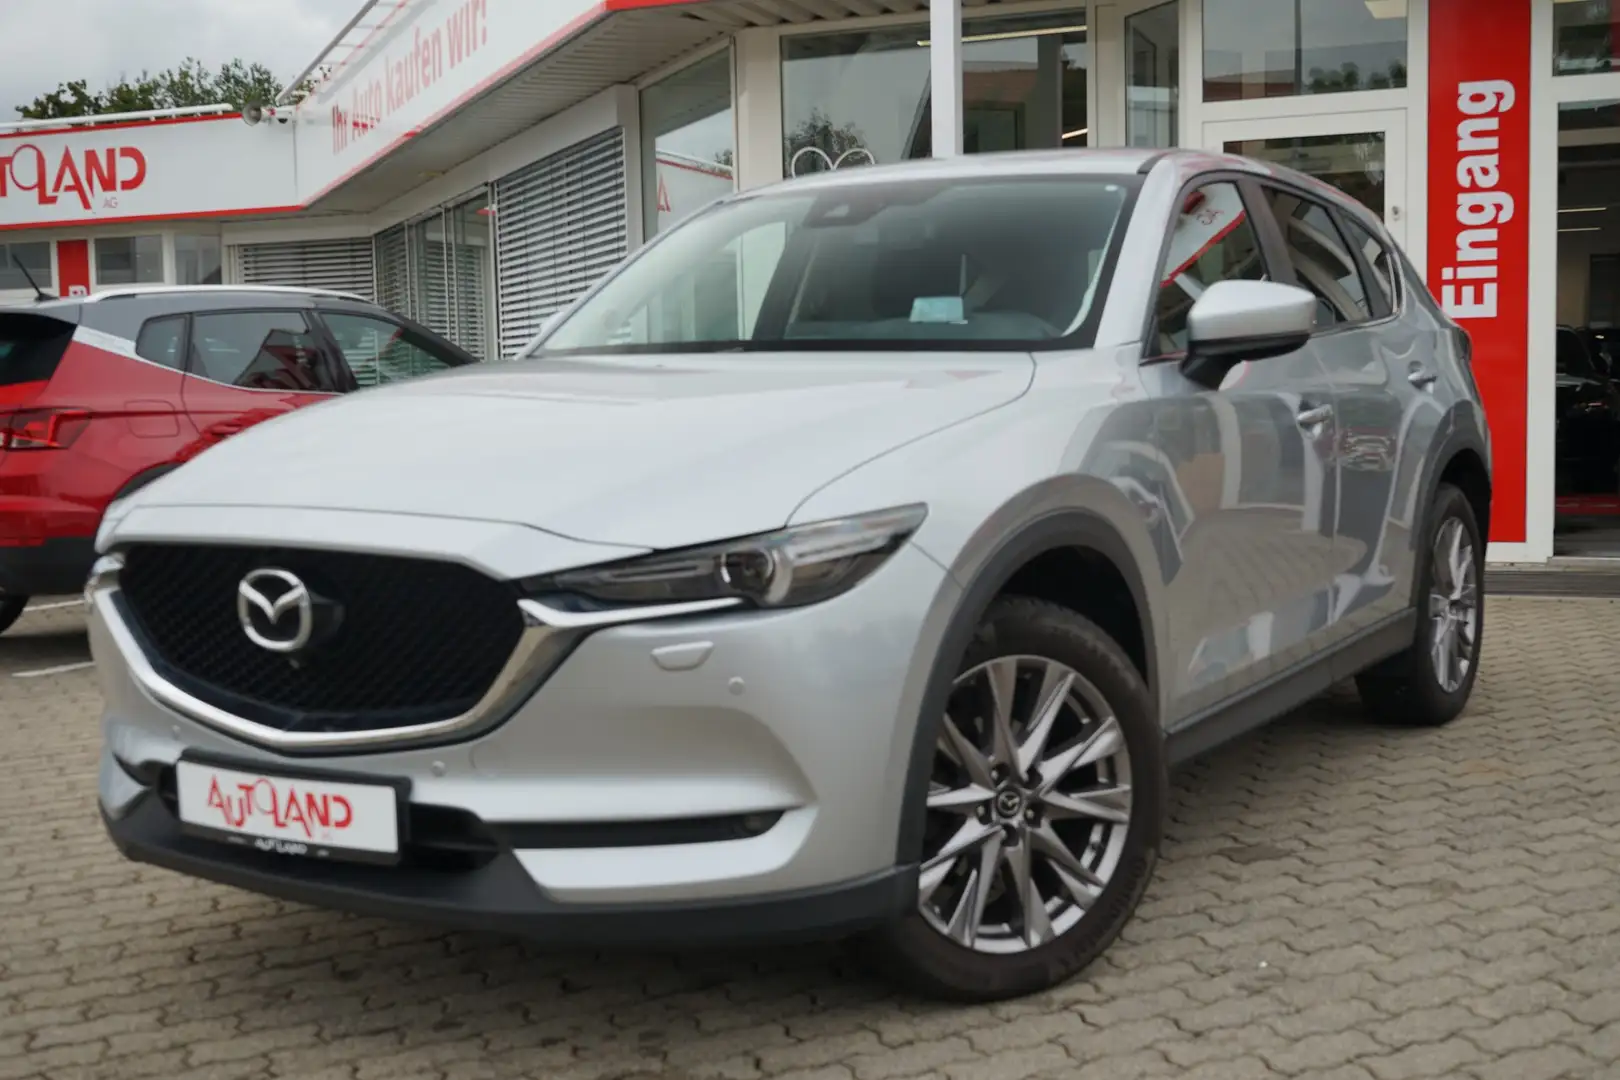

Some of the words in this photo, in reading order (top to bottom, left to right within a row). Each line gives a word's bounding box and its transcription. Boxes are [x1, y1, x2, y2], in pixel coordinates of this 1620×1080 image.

[351, 79, 382, 142] Auto
[384, 25, 443, 116] kaufen
[102, 197, 118, 209] AG
[1441, 79, 1516, 320] Eingang
